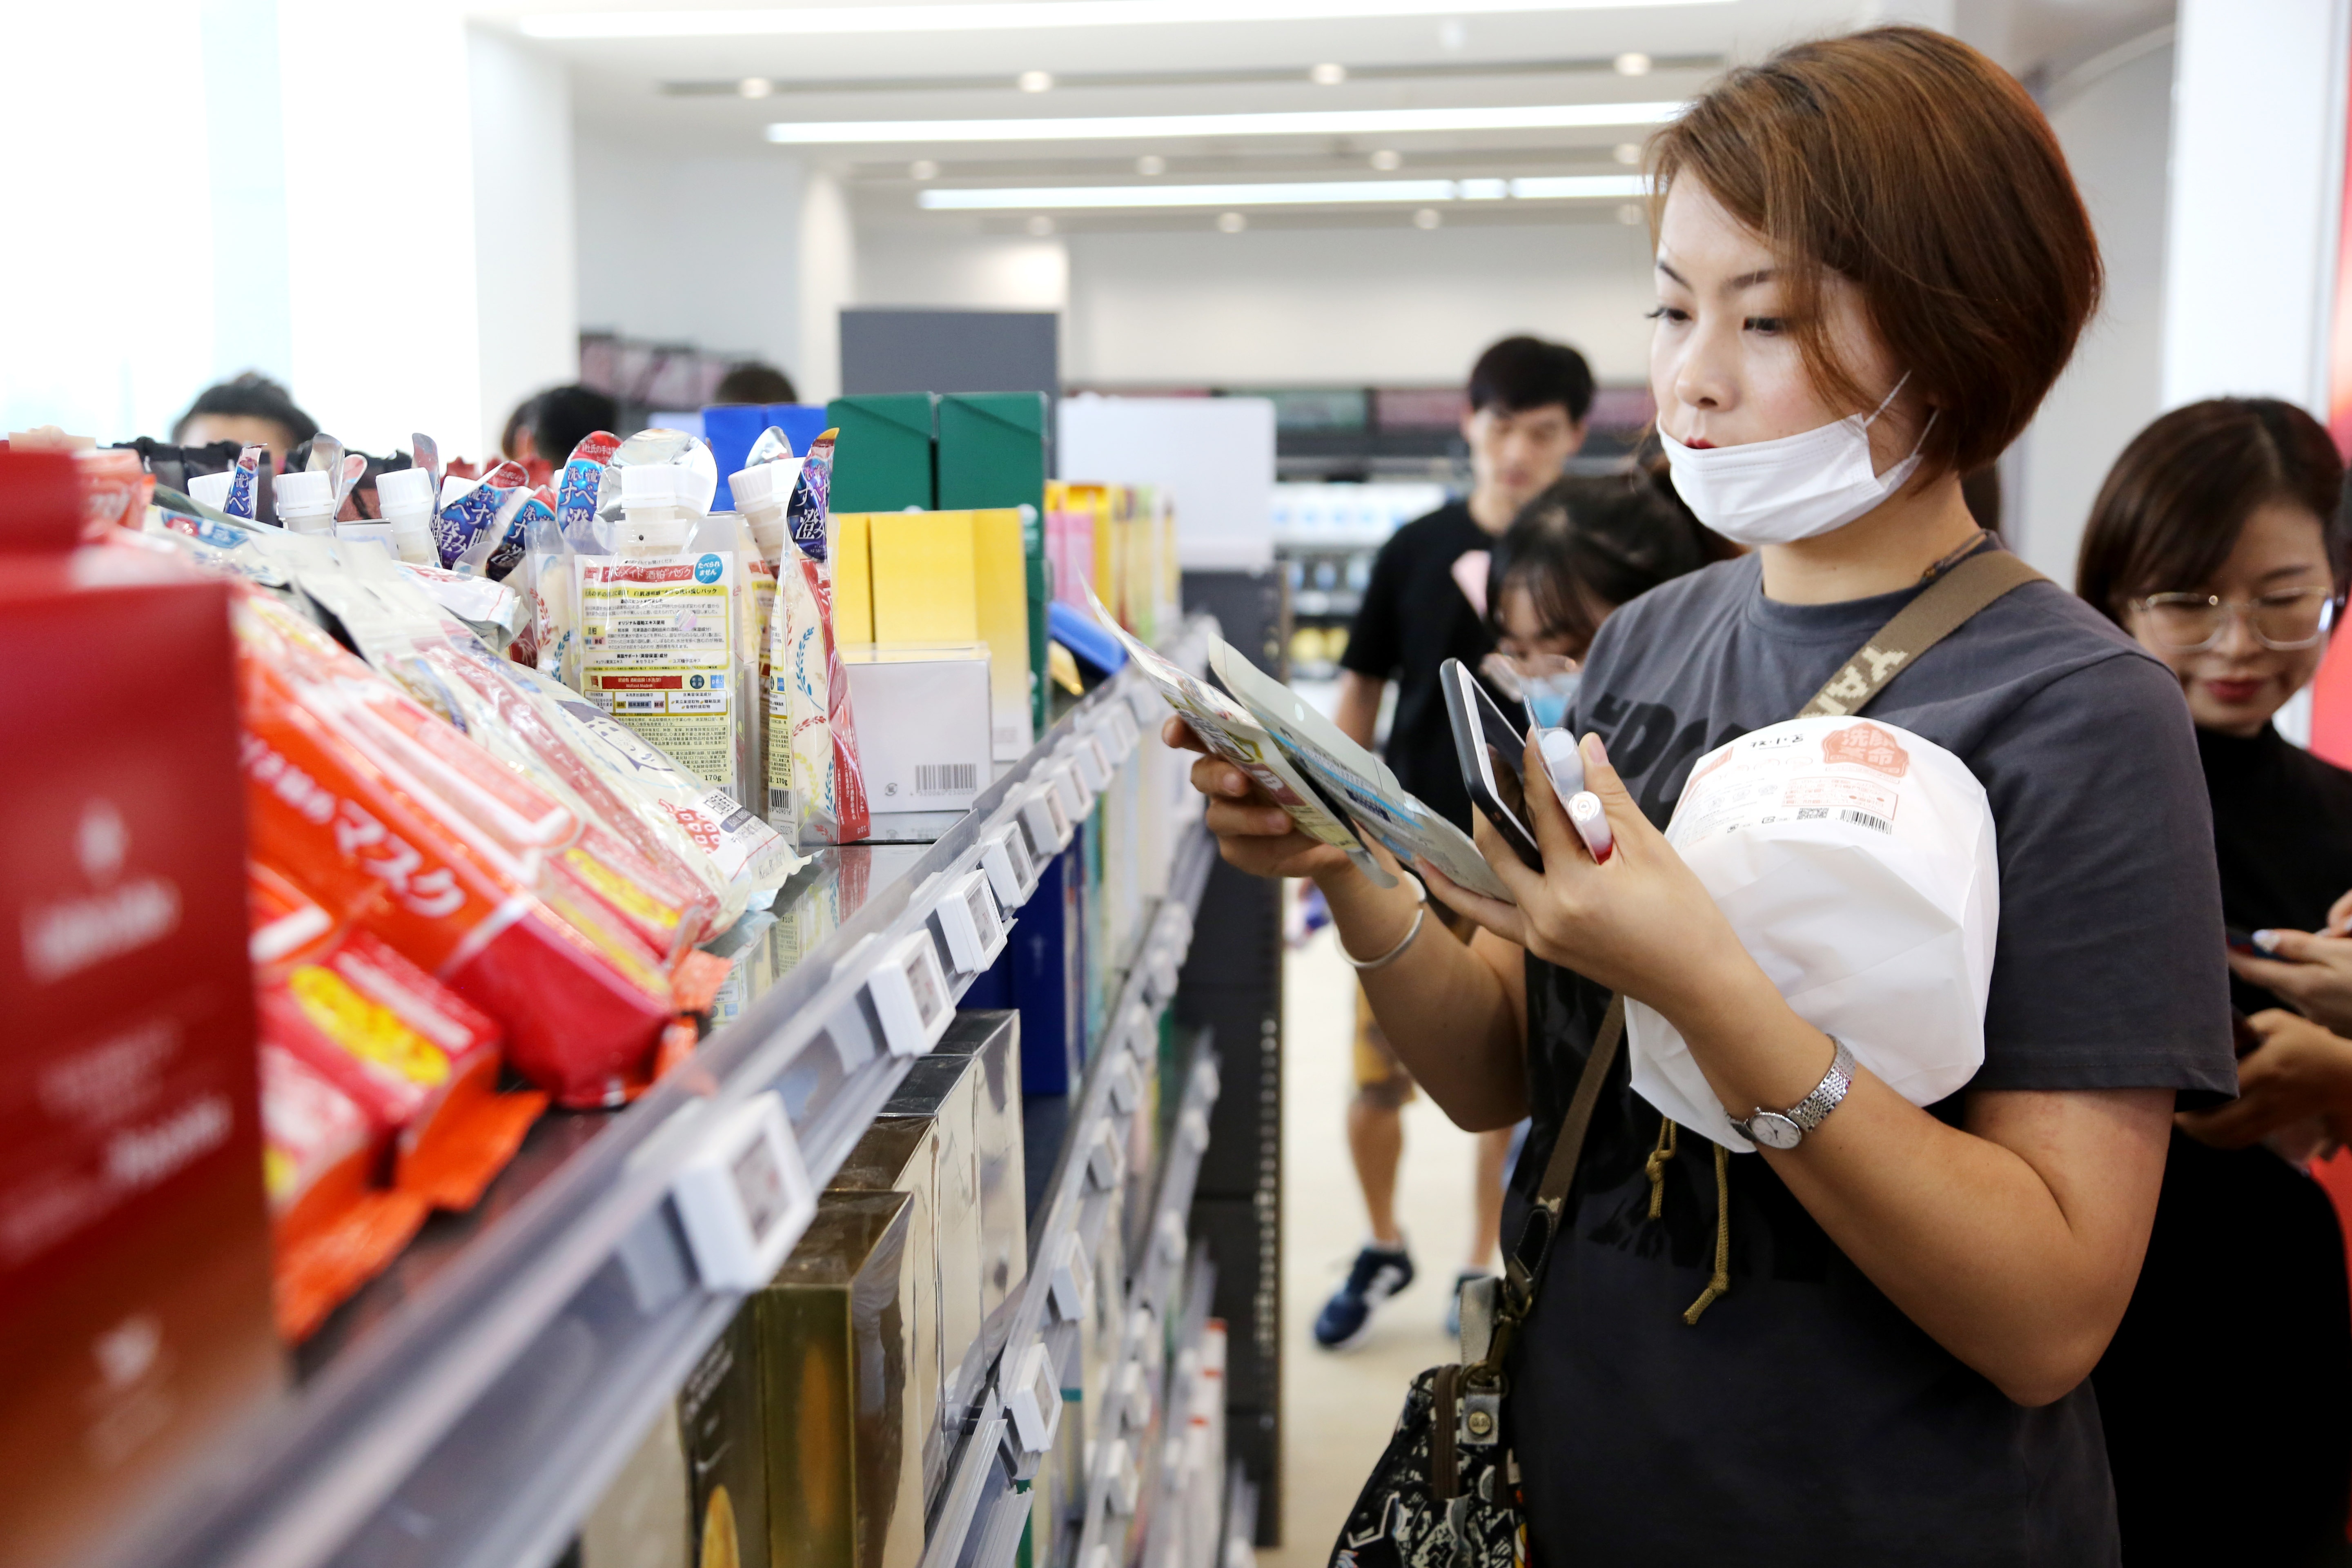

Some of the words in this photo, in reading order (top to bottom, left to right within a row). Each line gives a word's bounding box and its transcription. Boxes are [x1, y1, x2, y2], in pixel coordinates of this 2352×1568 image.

[697, 561, 721, 569] たべられ
[776, 777, 788, 786] 170g
